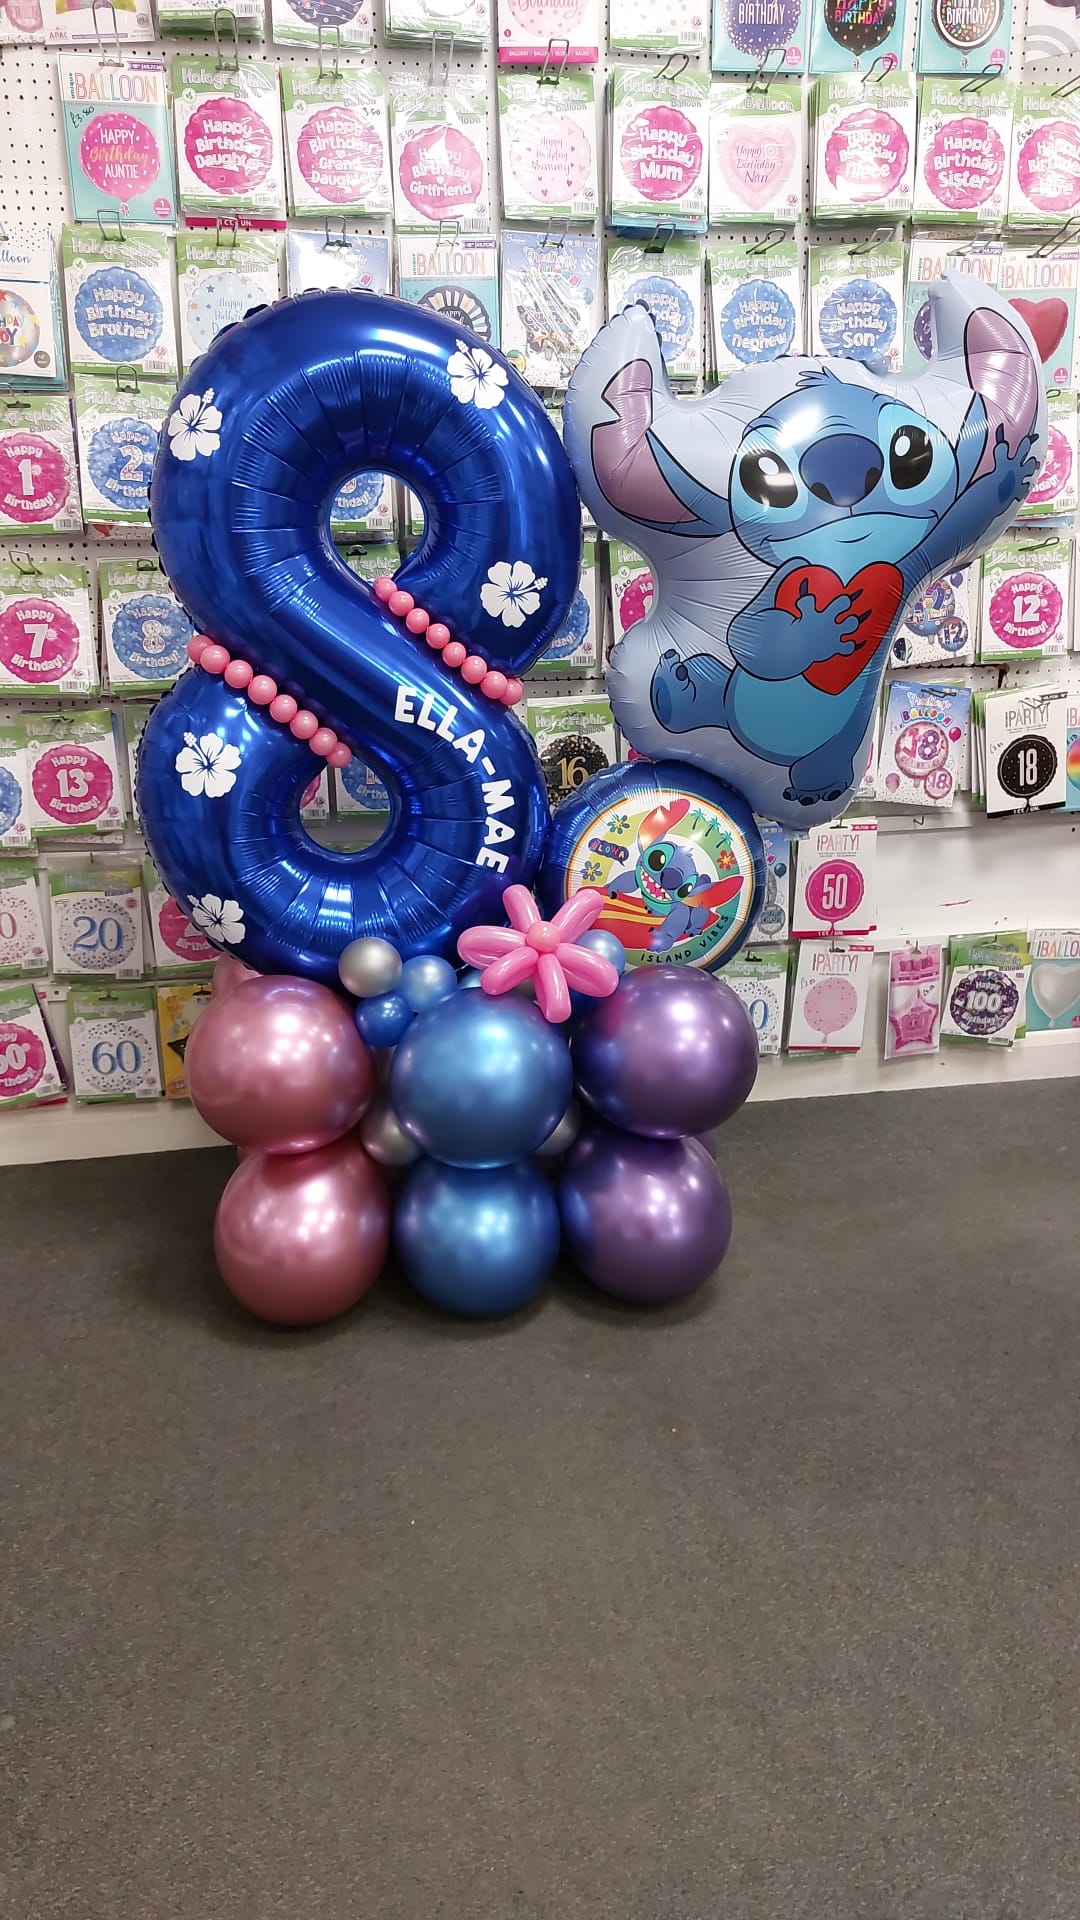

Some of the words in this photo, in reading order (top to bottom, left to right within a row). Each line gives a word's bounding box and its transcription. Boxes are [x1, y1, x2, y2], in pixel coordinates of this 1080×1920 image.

[739, 3, 785, 25] BIRTHDAY
[835, 9, 885, 24] BIRTHDAY
[946, 7, 989, 25] BIRTHDAY
[75, 72, 158, 103] BALLOON
[671, 98, 702, 107] Balloon
[745, 95, 794, 111] Balloon
[877, 99, 909, 109] Balloon
[931, 88, 1011, 111] Holographic
[976, 108, 1007, 119] Balloon
[100, 128, 135, 144] HAPPY
[202, 119, 254, 138] Happy
[315, 119, 363, 137] Happy
[638, 127, 689, 147] Happy
[736, 144, 763, 158] Happy
[944, 135, 994, 156] Happy
[89, 145, 149, 165] Birthday
[319, 156, 362, 170] Grand
[630, 144, 695, 166] Birthday
[933, 152, 999, 174] Birthday
[104, 164, 139, 179] AUNTIE
[640, 161, 683, 182] Mum
[736, 158, 776, 173] Birthday
[744, 171, 769, 184] Nan
[938, 169, 990, 190] Sister
[409, 180, 472, 197] Girlfriend
[416, 252, 486, 276] BALLOON
[662, 268, 693, 277] Balloon
[763, 269, 792, 279] Balloon
[866, 269, 895, 279] Balloon
[1005, 264, 1073, 288] BALLOON
[93, 286, 145, 306] Happy
[85, 304, 155, 328] Birthday
[739, 300, 779, 314] Happy
[836, 301, 881, 315] Happy
[87, 321, 154, 341] Brother
[732, 313, 787, 331] Birthday
[110, 430, 150, 445] Happy
[4, 445, 43, 458] Happy
[3, 491, 57, 512] Birthday!
[1011, 582, 1044, 594] Happy
[16, 608, 55, 624] Happy
[130, 606, 170, 619] Happy
[1002, 620, 1049, 637] Birthday!
[10, 652, 66, 673] Birthday!
[128, 647, 182, 668] Birthday!
[901, 707, 952, 726] BALLOON
[51, 755, 88, 768] Happy
[1017, 748, 1038, 787] 18
[394, 685, 515, 874] ELLA-MAE
[557, 756, 589, 790] 16
[49, 797, 101, 814] Birthday!
[590, 840, 626, 860] ALOHA
[821, 873, 848, 910] 50
[72, 915, 124, 953] 20
[640, 949, 692, 963] ISLAND
[699, 915, 730, 948] VIBES
[962, 1012, 999, 1030] Birthday!
[92, 1039, 142, 1076] 60
